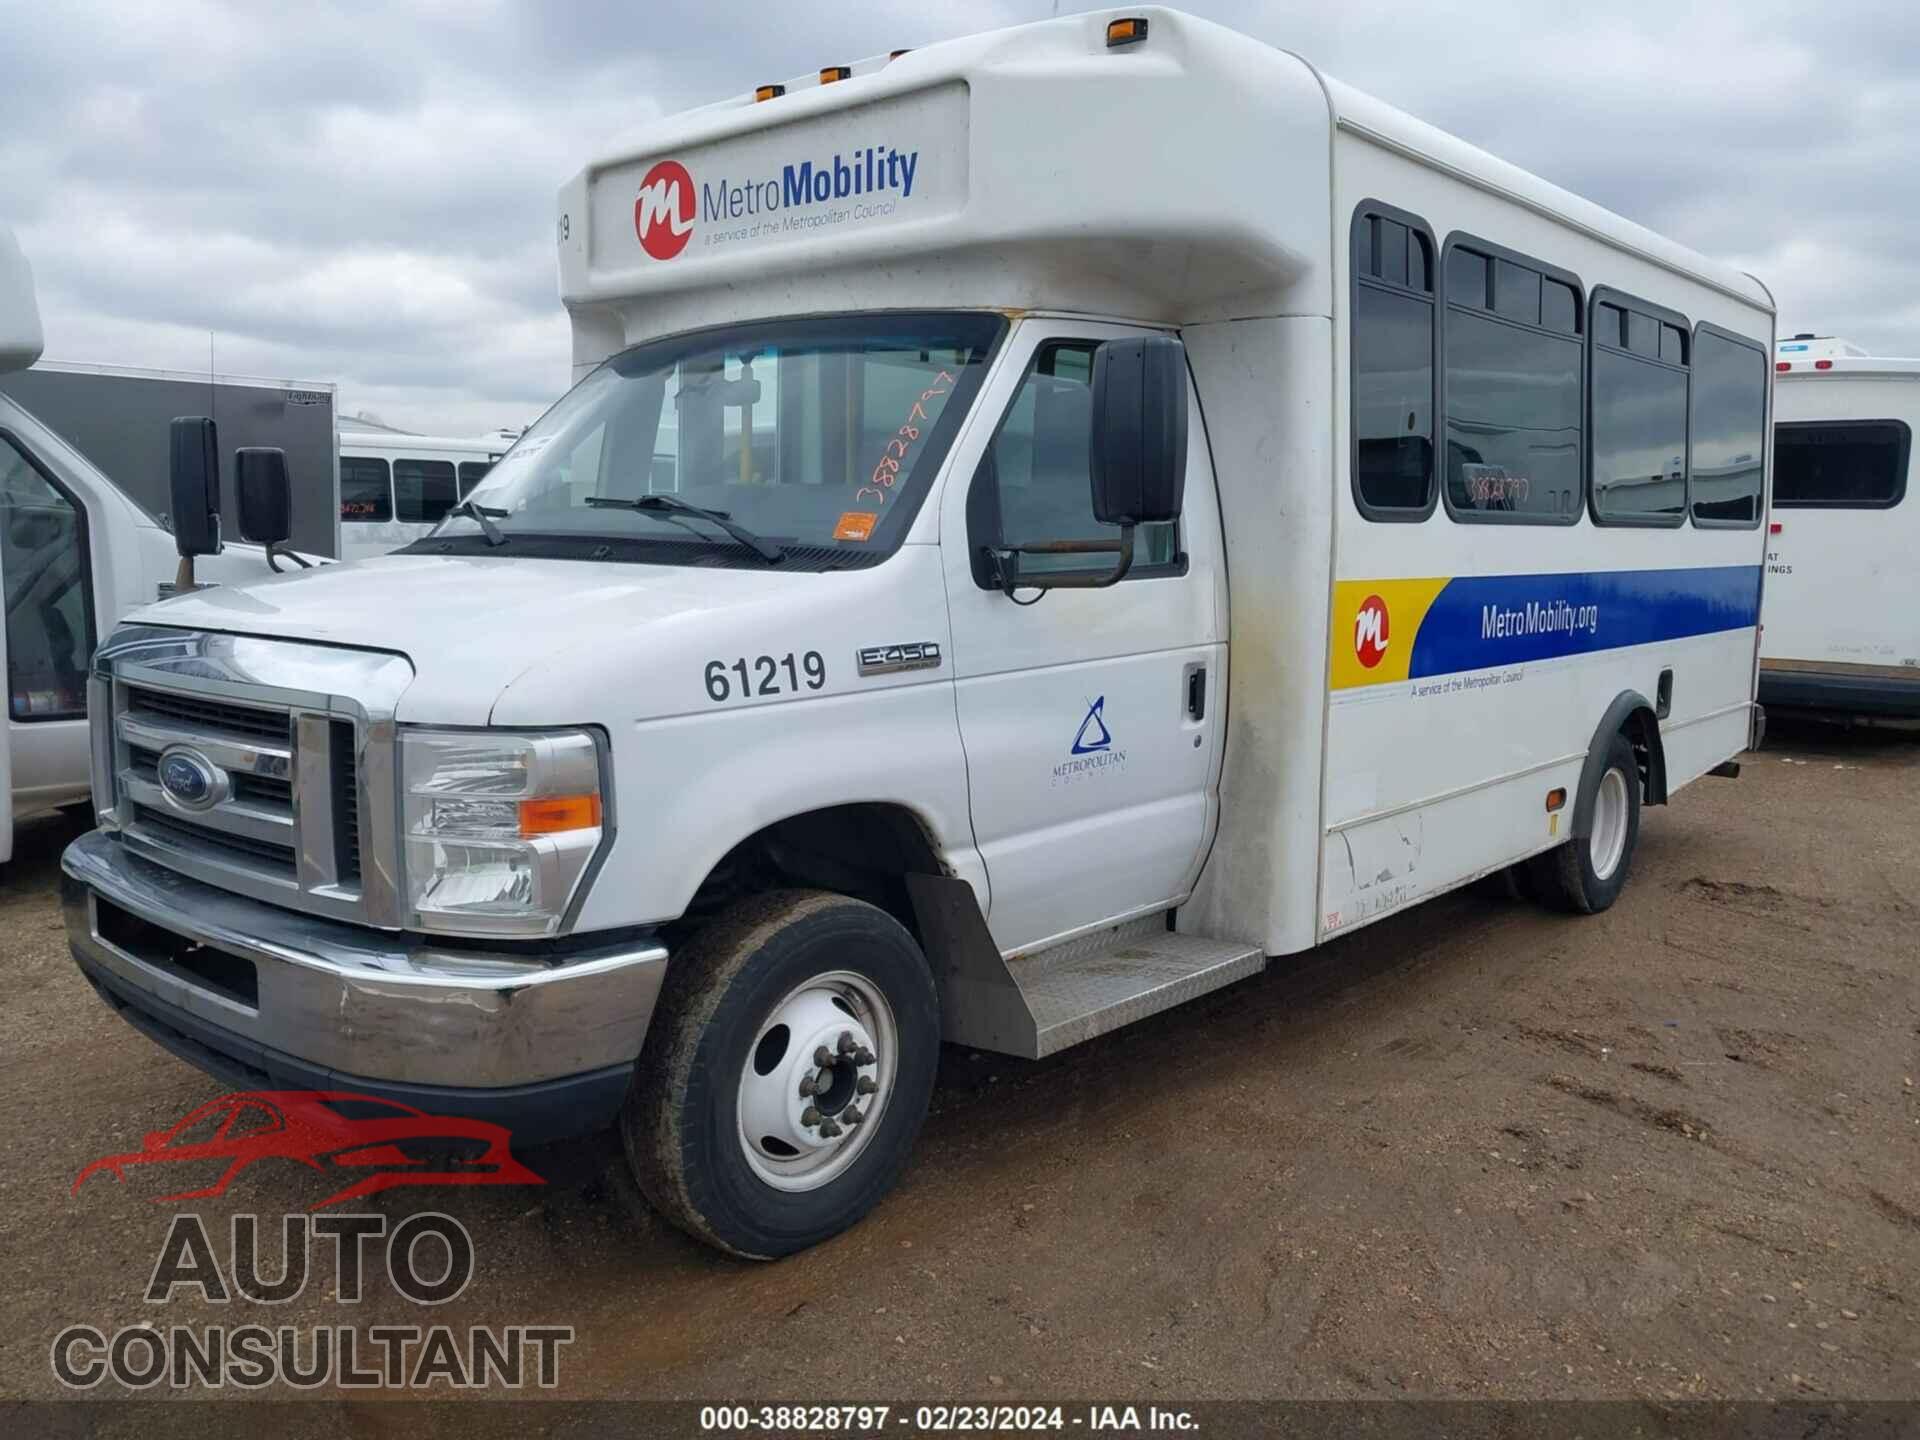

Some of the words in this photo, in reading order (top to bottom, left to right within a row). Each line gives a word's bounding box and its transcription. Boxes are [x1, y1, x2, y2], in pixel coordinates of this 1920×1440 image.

[713, 228, 748, 244] service
[750, 221, 761, 238] of
[764, 222, 779, 235] the
[782, 208, 850, 233] Metropolitan
[854, 200, 897, 220] Council
[1481, 600, 1598, 639] MetroMobility.org
[704, 650, 827, 702] 61219
[1410, 685, 1418, 698] A
[1418, 685, 1442, 697] service
[1452, 679, 1462, 692] the
[1463, 672, 1501, 692] Metropolitan
[1502, 668, 1525, 684] Council
[1053, 750, 1128, 777] METROPOLITAN
